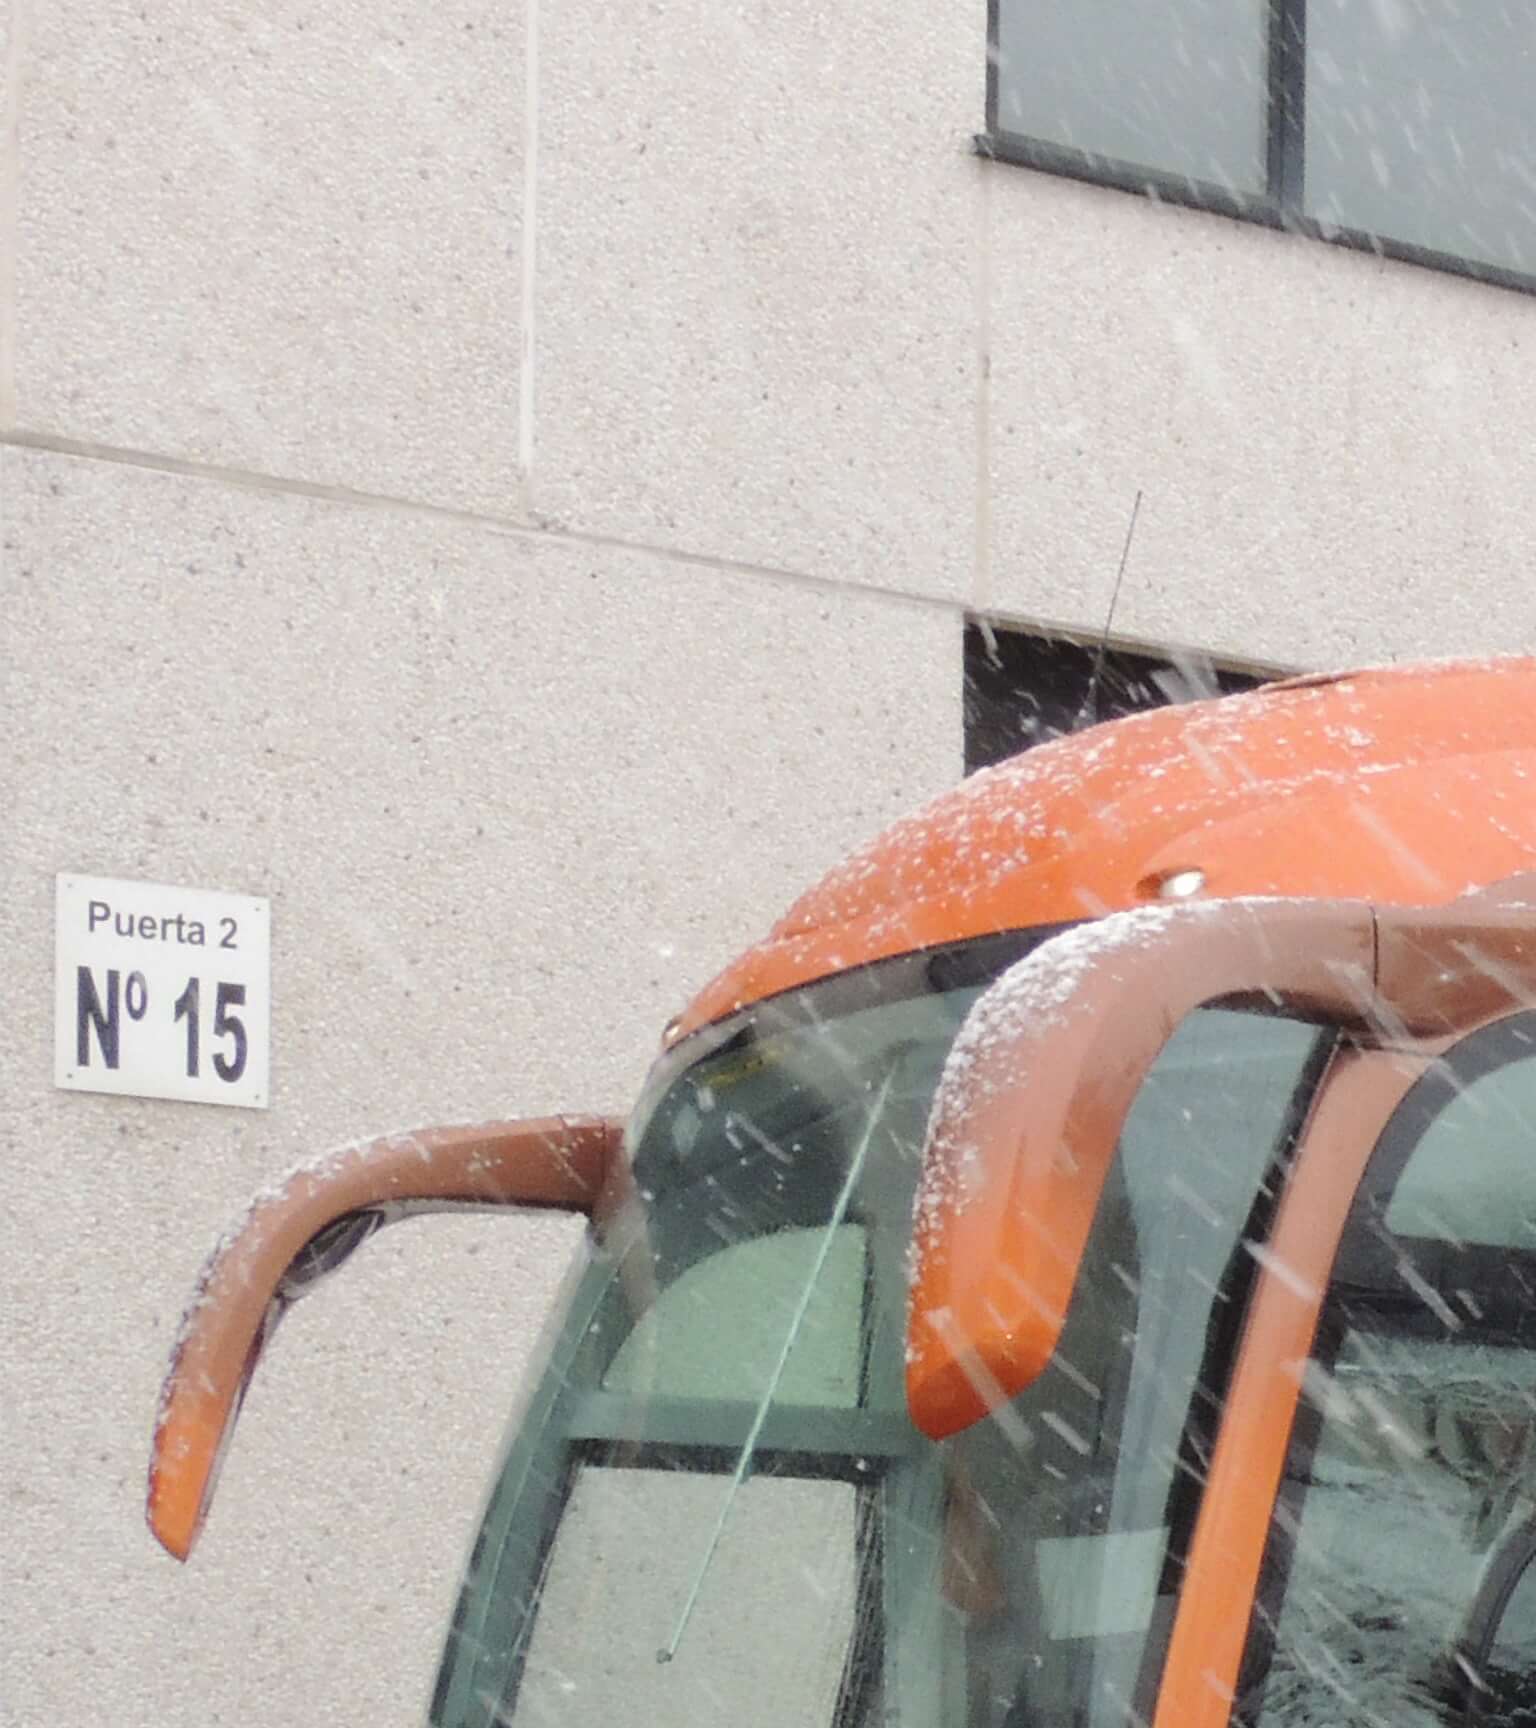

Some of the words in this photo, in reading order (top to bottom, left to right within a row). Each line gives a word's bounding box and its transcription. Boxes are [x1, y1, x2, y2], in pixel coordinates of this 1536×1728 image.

[88, 900, 206, 946] Puerta
[219, 917, 239, 950] 2
[173, 976, 249, 1083] 15
